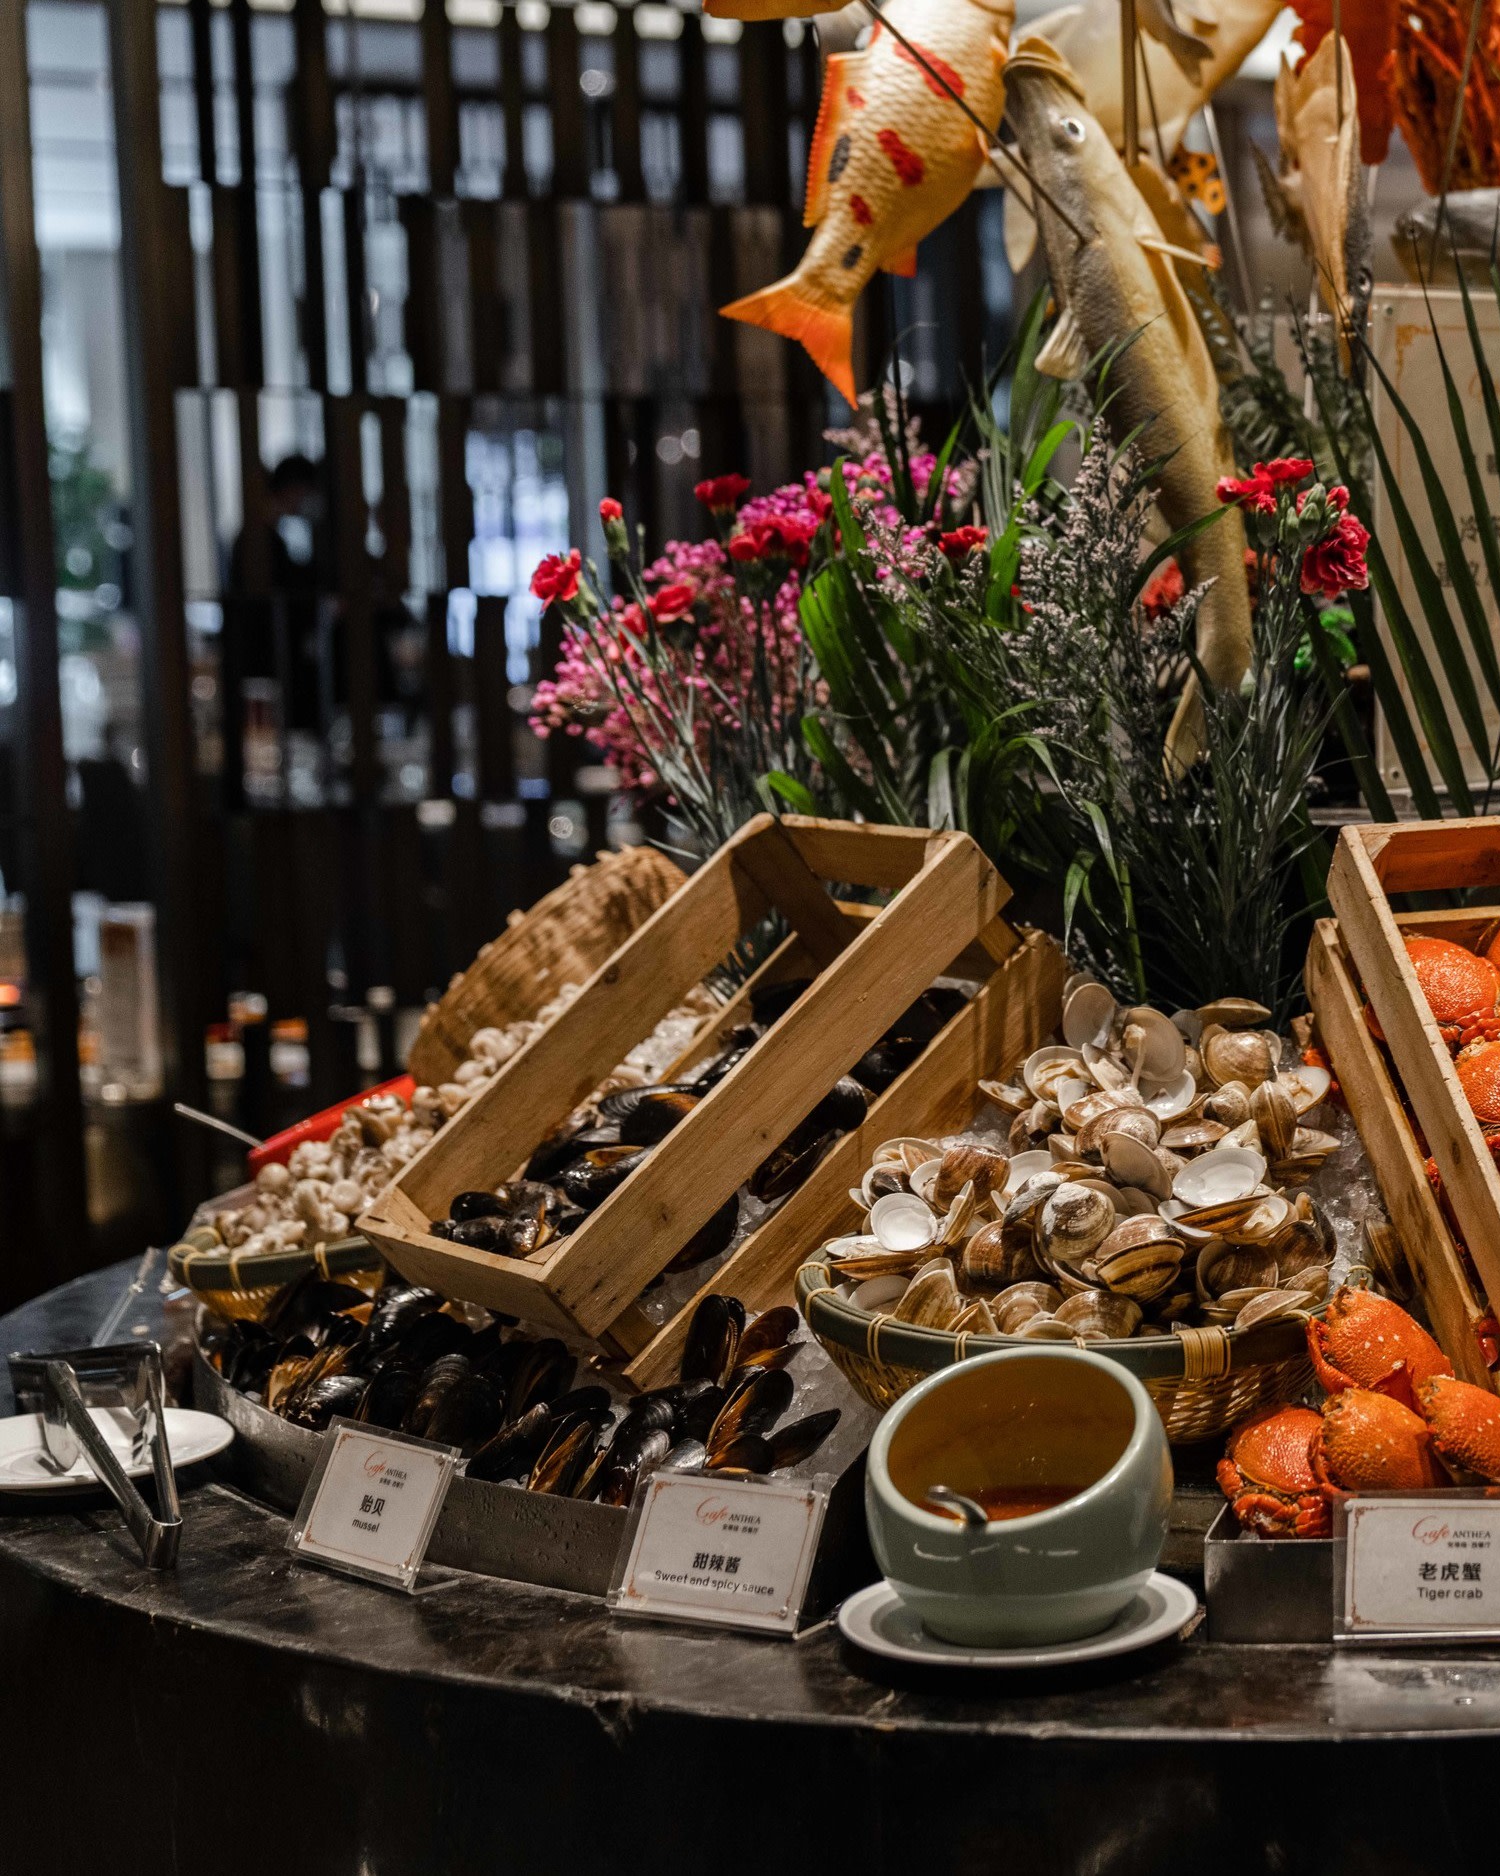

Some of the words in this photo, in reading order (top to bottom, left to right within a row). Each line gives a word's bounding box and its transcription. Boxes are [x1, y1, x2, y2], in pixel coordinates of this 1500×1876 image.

[359, 1494, 386, 1517] 贻贝
[352, 1518, 380, 1533] mussel
[728, 1513, 761, 1525] ANTHEA
[1452, 1530, 1491, 1539] ANTHEA
[692, 1552, 741, 1574] 甜辣酱
[1418, 1562, 1481, 1581] 老虎蟹
[654, 1570, 688, 1585] Sweet
[690, 1574, 710, 1587] and
[711, 1578, 741, 1594] spicy
[742, 1583, 775, 1596] sauce
[1417, 1587, 1450, 1601] Tiger
[1454, 1587, 1483, 1599] crab
